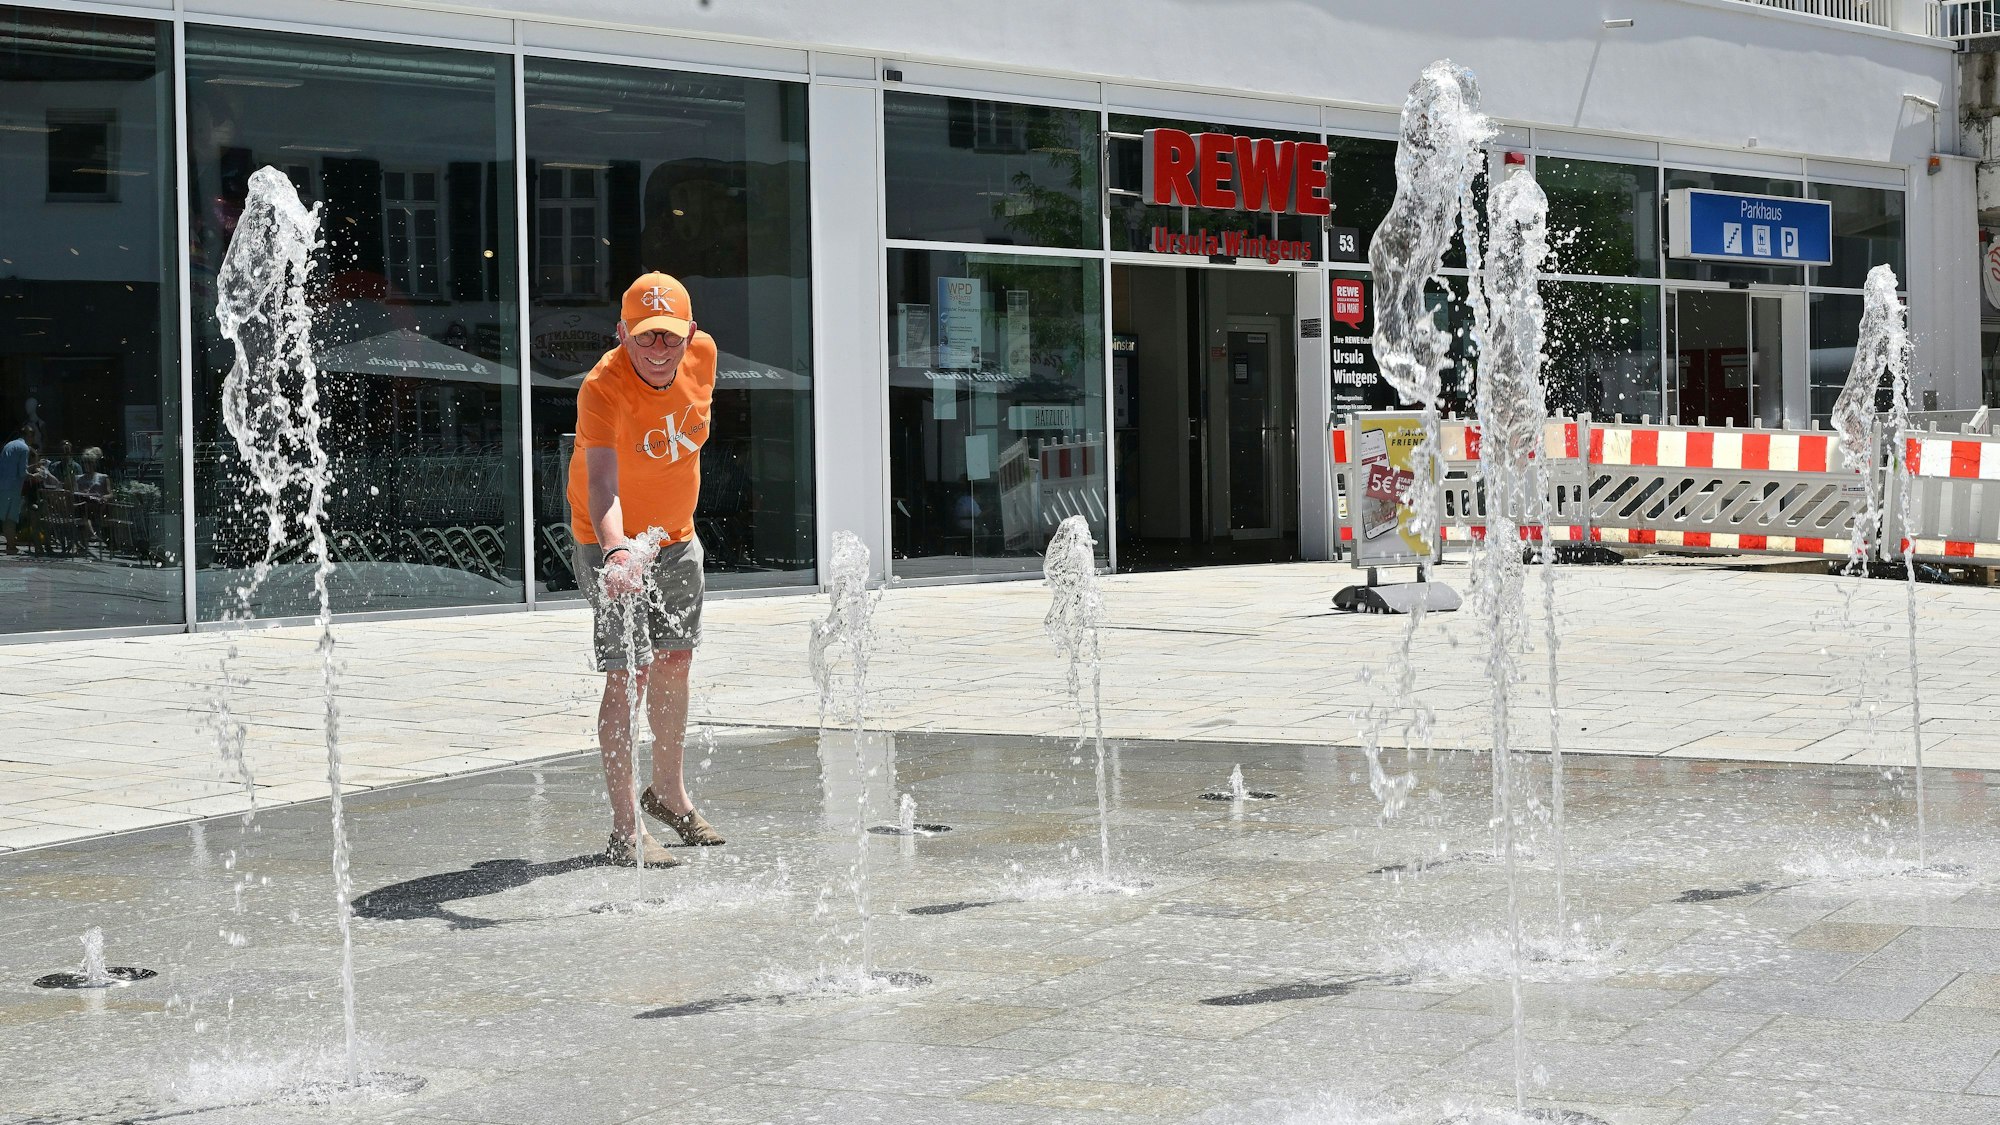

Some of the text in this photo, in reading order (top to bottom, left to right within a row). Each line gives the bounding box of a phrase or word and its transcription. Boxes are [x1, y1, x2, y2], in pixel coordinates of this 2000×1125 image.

[1150, 128, 1330, 216] REWE
[1740, 200, 1783, 221] Parkhaus
[1153, 227, 1312, 264] Ursula Wintgens
[1339, 234, 1354, 252] 53
[1785, 231, 1794, 253] P
[948, 283, 972, 295] WPD
[1336, 286, 1359, 297] REWE
[1112, 338, 1134, 351] instar
[1345, 336, 1360, 344] REWE
[1333, 349, 1364, 364] Ursula
[1333, 369, 1378, 387] Wintgens
[635, 440, 666, 452] Calvin
[1371, 474, 1394, 494] 5€
